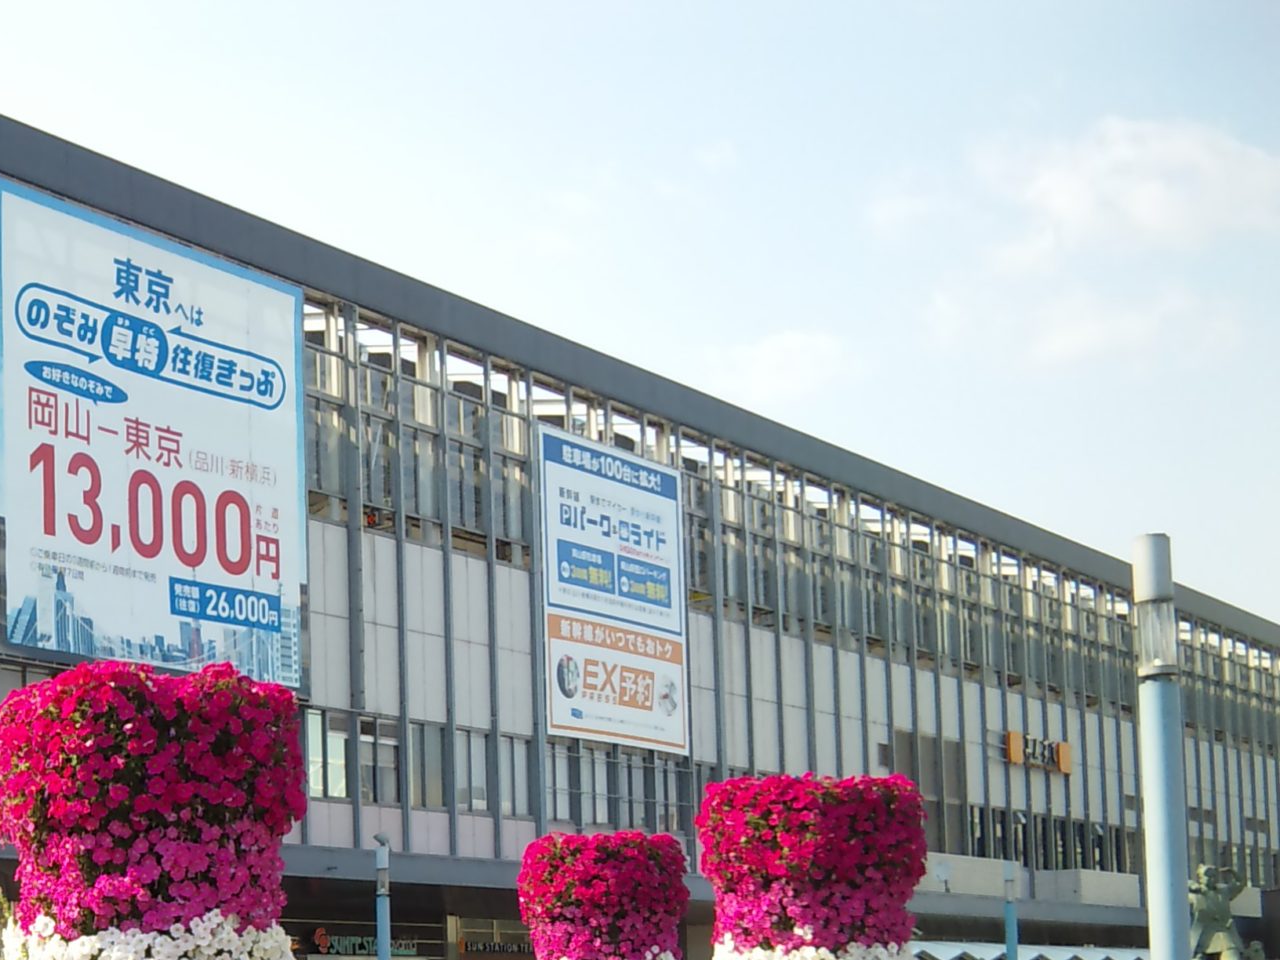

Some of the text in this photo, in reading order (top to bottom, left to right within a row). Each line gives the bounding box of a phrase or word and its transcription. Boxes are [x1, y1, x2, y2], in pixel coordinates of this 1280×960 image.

[112, 257, 204, 328] 東京へは
[41, 365, 114, 401] お好きなのぞみで
[205, 588, 279, 627] 26,000円
[485, 942, 518, 953] STATION
